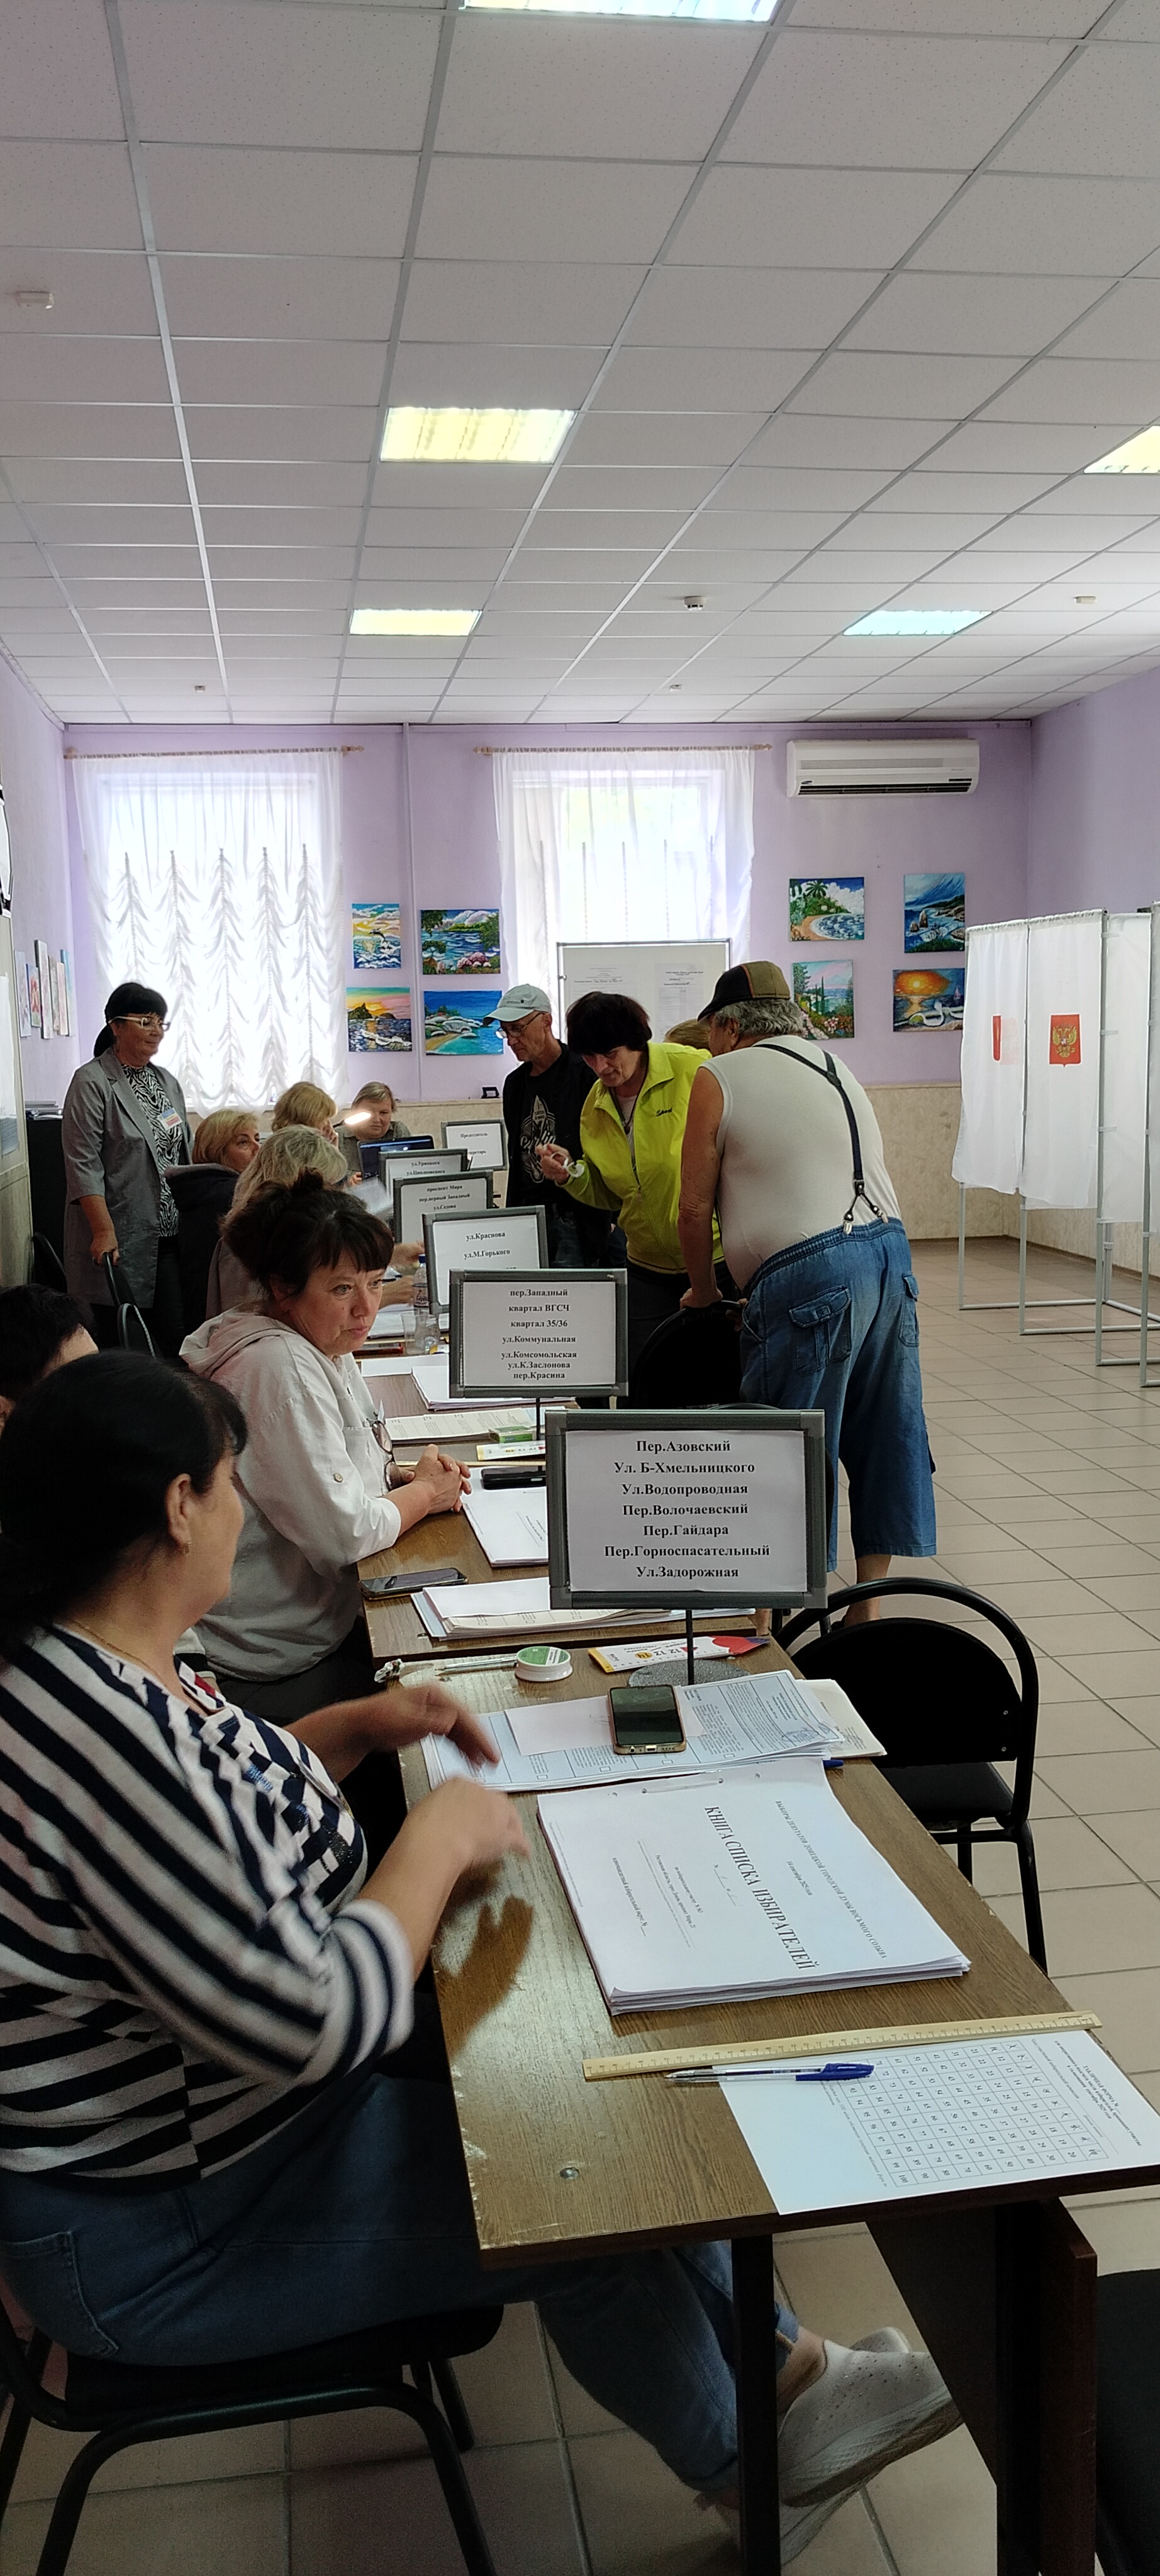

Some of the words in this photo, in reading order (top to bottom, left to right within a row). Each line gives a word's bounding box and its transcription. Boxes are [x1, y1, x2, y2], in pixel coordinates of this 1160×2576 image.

[466, 1232, 506, 1242] ул.Краснова
[464, 1250, 510, 1260] ул.М.Горького
[510, 1289, 568, 1298] пер.Западный
[545, 1304, 569, 1312] ВГСЧ
[546, 1319, 568, 1328] 35/36
[502, 1335, 576, 1345] ул.Коммунальная
[501, 1351, 577, 1360] ул.Комсомольская
[508, 1361, 571, 1370] ул.К.Заслонова
[513, 1371, 565, 1381] пер.Красина
[637, 1440, 730, 1455] Пер.Азовский
[614, 1462, 636, 1474] Ул.
[640, 1462, 755, 1474] Б-Хмельницкого
[622, 1484, 748, 1497] Ул.Водопроводная
[623, 1503, 748, 1518] Пер.Волочаевский
[644, 1524, 728, 1539] Пер.Гайдара
[605, 1545, 769, 1559] Пер.Горноспасательный
[636, 1566, 739, 1580] Ул.Задорожная
[775, 1801, 792, 1820] ВЫБОРЫ
[786, 1821, 808, 1843] ДЕПУТАТОВ
[803, 1845, 825, 1869] ДОНЕЦКОЙ
[820, 1869, 844, 1895] ГОРОДСКОЙ
[838, 1896, 854, 1909] ДУМЫ
[849, 1909, 873, 1938] ВОСЬМОГО
[869, 1938, 887, 1958] СОЗЫВА
[705, 1806, 735, 1840] КНИГА
[725, 1841, 761, 1885] СПИСКА
[752, 1889, 820, 1969] ИЗБИРАТЕЛЕЙ
[898, 2174, 909, 2183] 100
